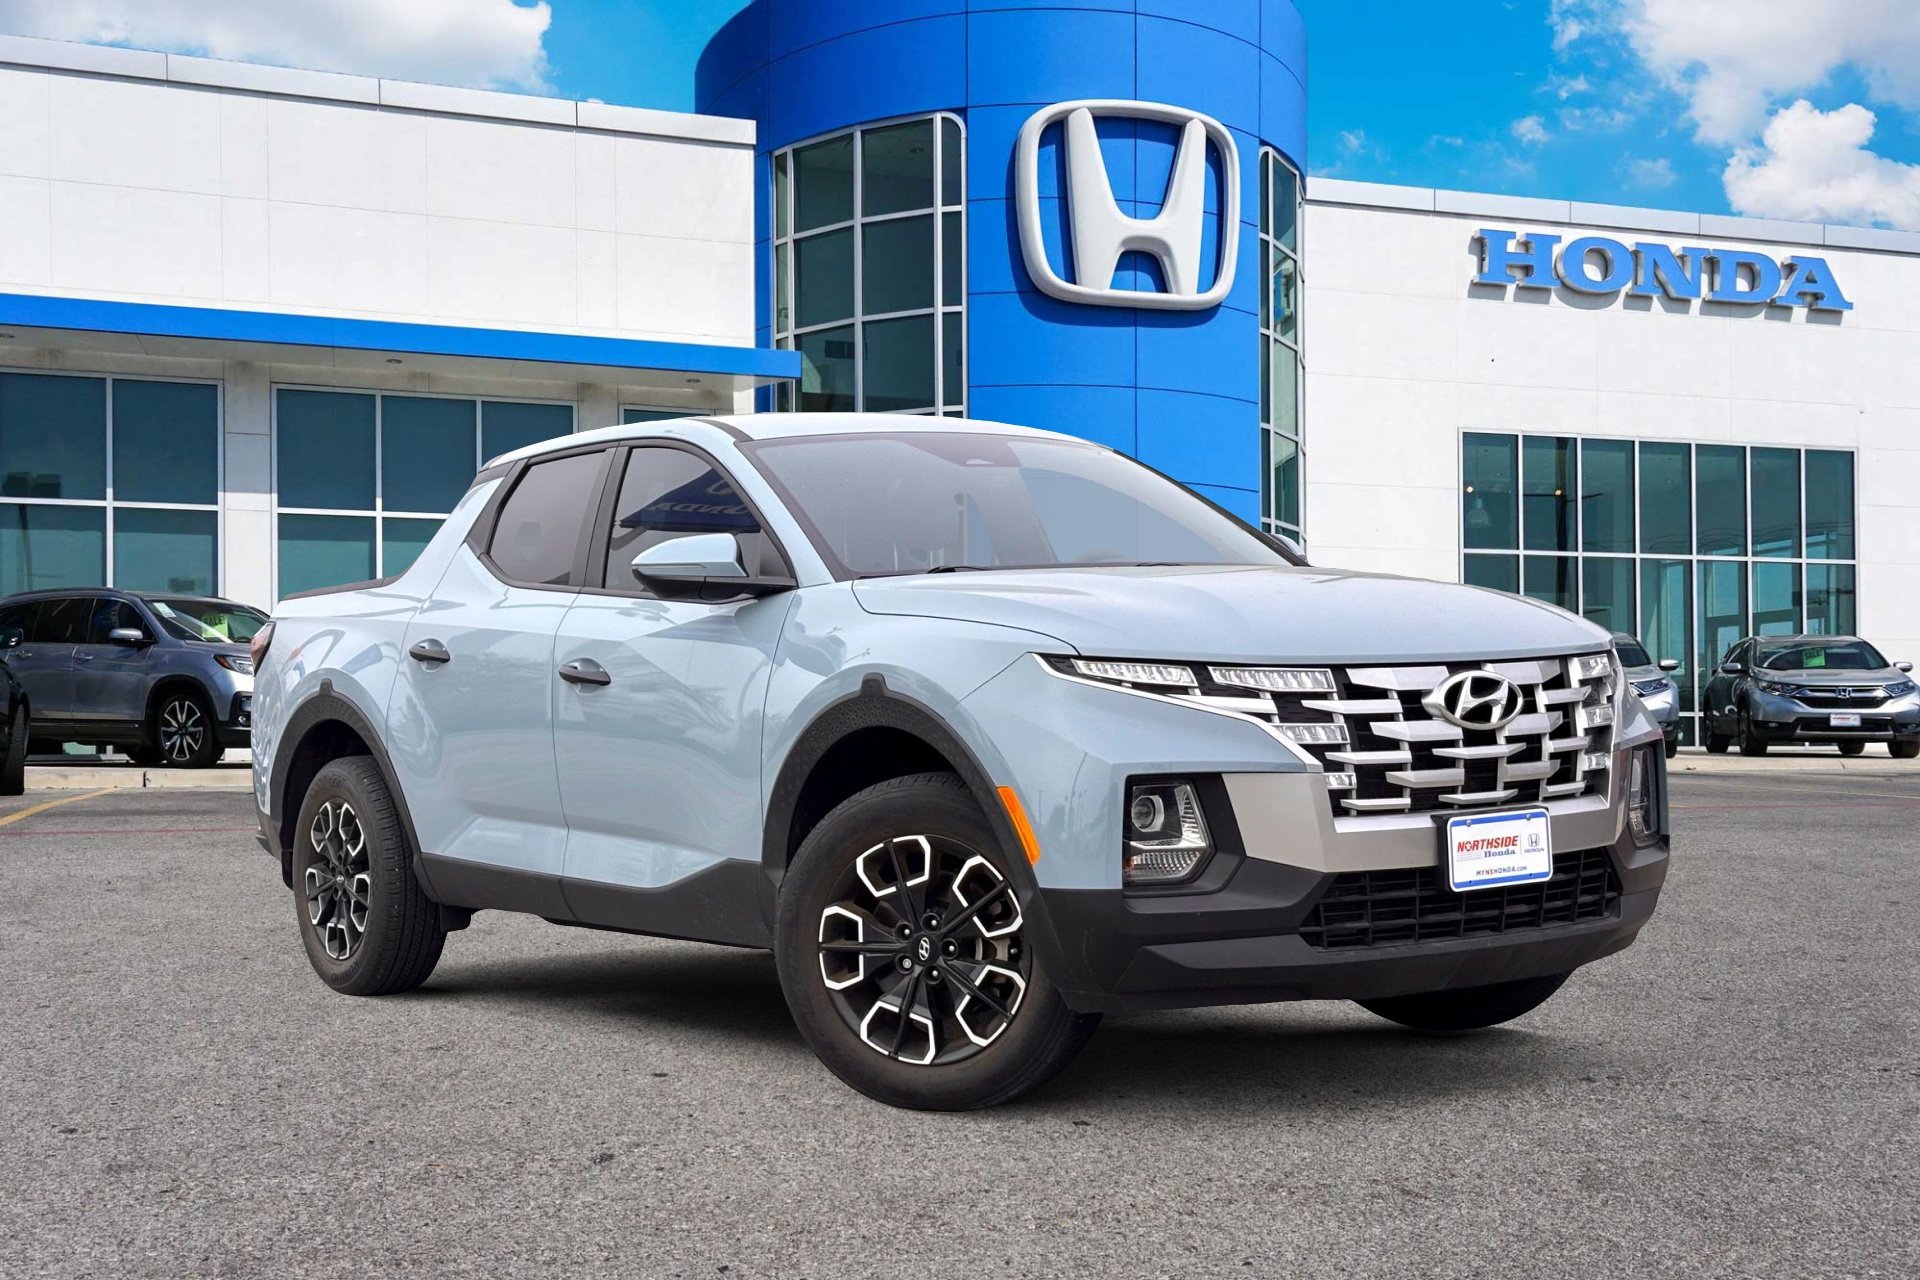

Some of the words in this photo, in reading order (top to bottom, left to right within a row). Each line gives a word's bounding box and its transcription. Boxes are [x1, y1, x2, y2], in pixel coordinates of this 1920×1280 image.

[1473, 229, 1854, 312] HONDA
[1457, 835, 1518, 853] NORTHSIDE
[1484, 848, 1516, 858] Honda
